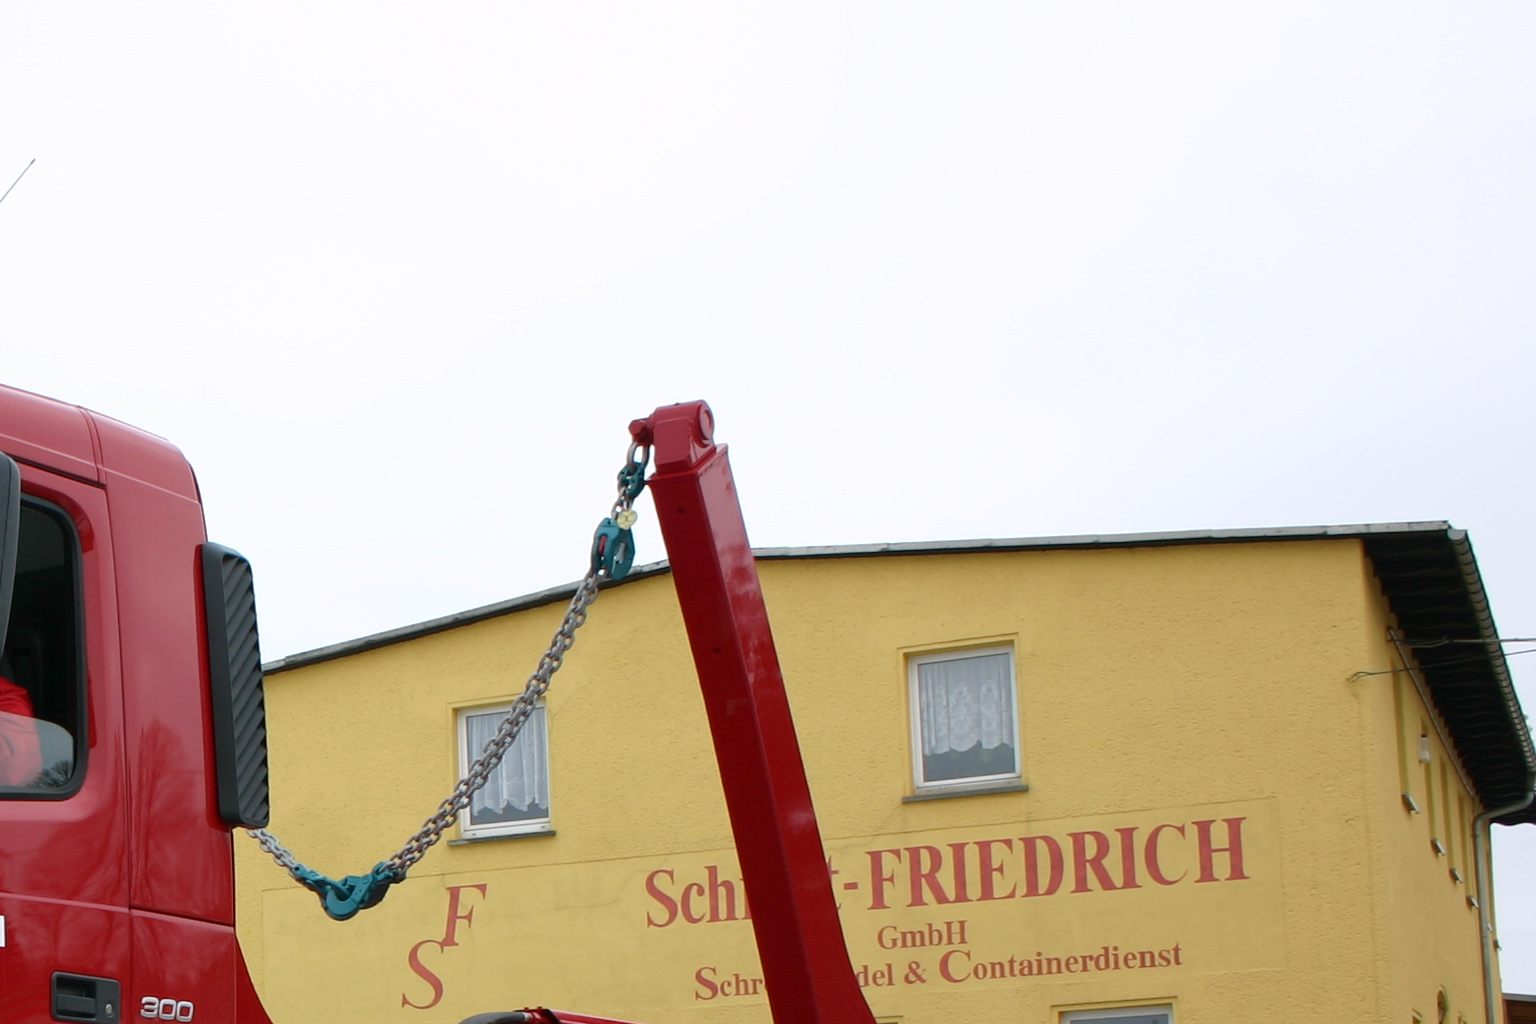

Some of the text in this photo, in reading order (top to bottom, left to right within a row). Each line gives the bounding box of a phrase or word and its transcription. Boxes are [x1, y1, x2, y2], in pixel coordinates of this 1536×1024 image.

[440, 883, 488, 948] F
[876, 920, 968, 950] GmbH
[401, 939, 444, 1010] S
[695, 942, 1183, 1001] Schrdel & Containerdienst
[139, 996, 194, 1022] 300
